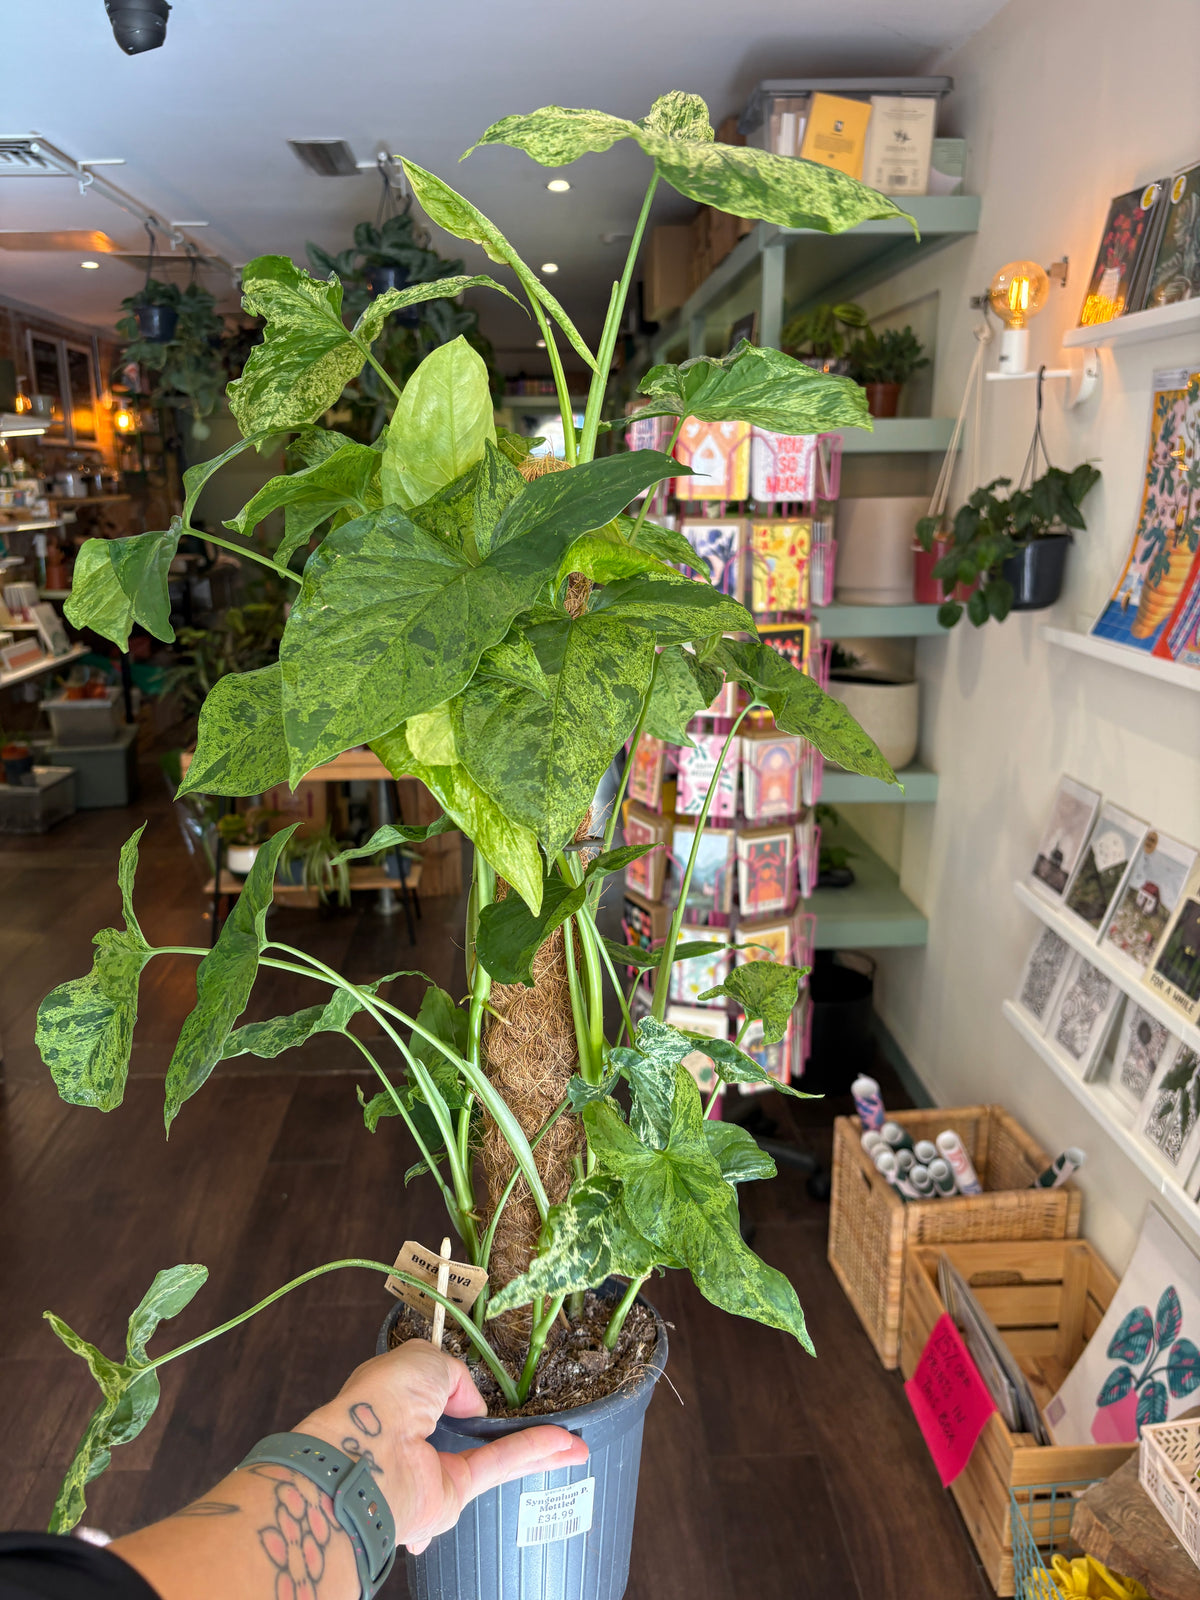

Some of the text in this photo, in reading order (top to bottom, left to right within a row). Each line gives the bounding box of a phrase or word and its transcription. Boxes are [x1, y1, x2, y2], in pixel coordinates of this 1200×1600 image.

[776, 437, 804, 454] YOU
[779, 456, 798, 474] SO
[766, 476, 806, 494] MUCH
[1150, 973, 1165, 990] FOR
[411, 1254, 472, 1288] Boraova
[526, 1491, 579, 1507] Syngonium
[539, 1498, 576, 1513] Mottled
[538, 1509, 574, 1524] £34.99
